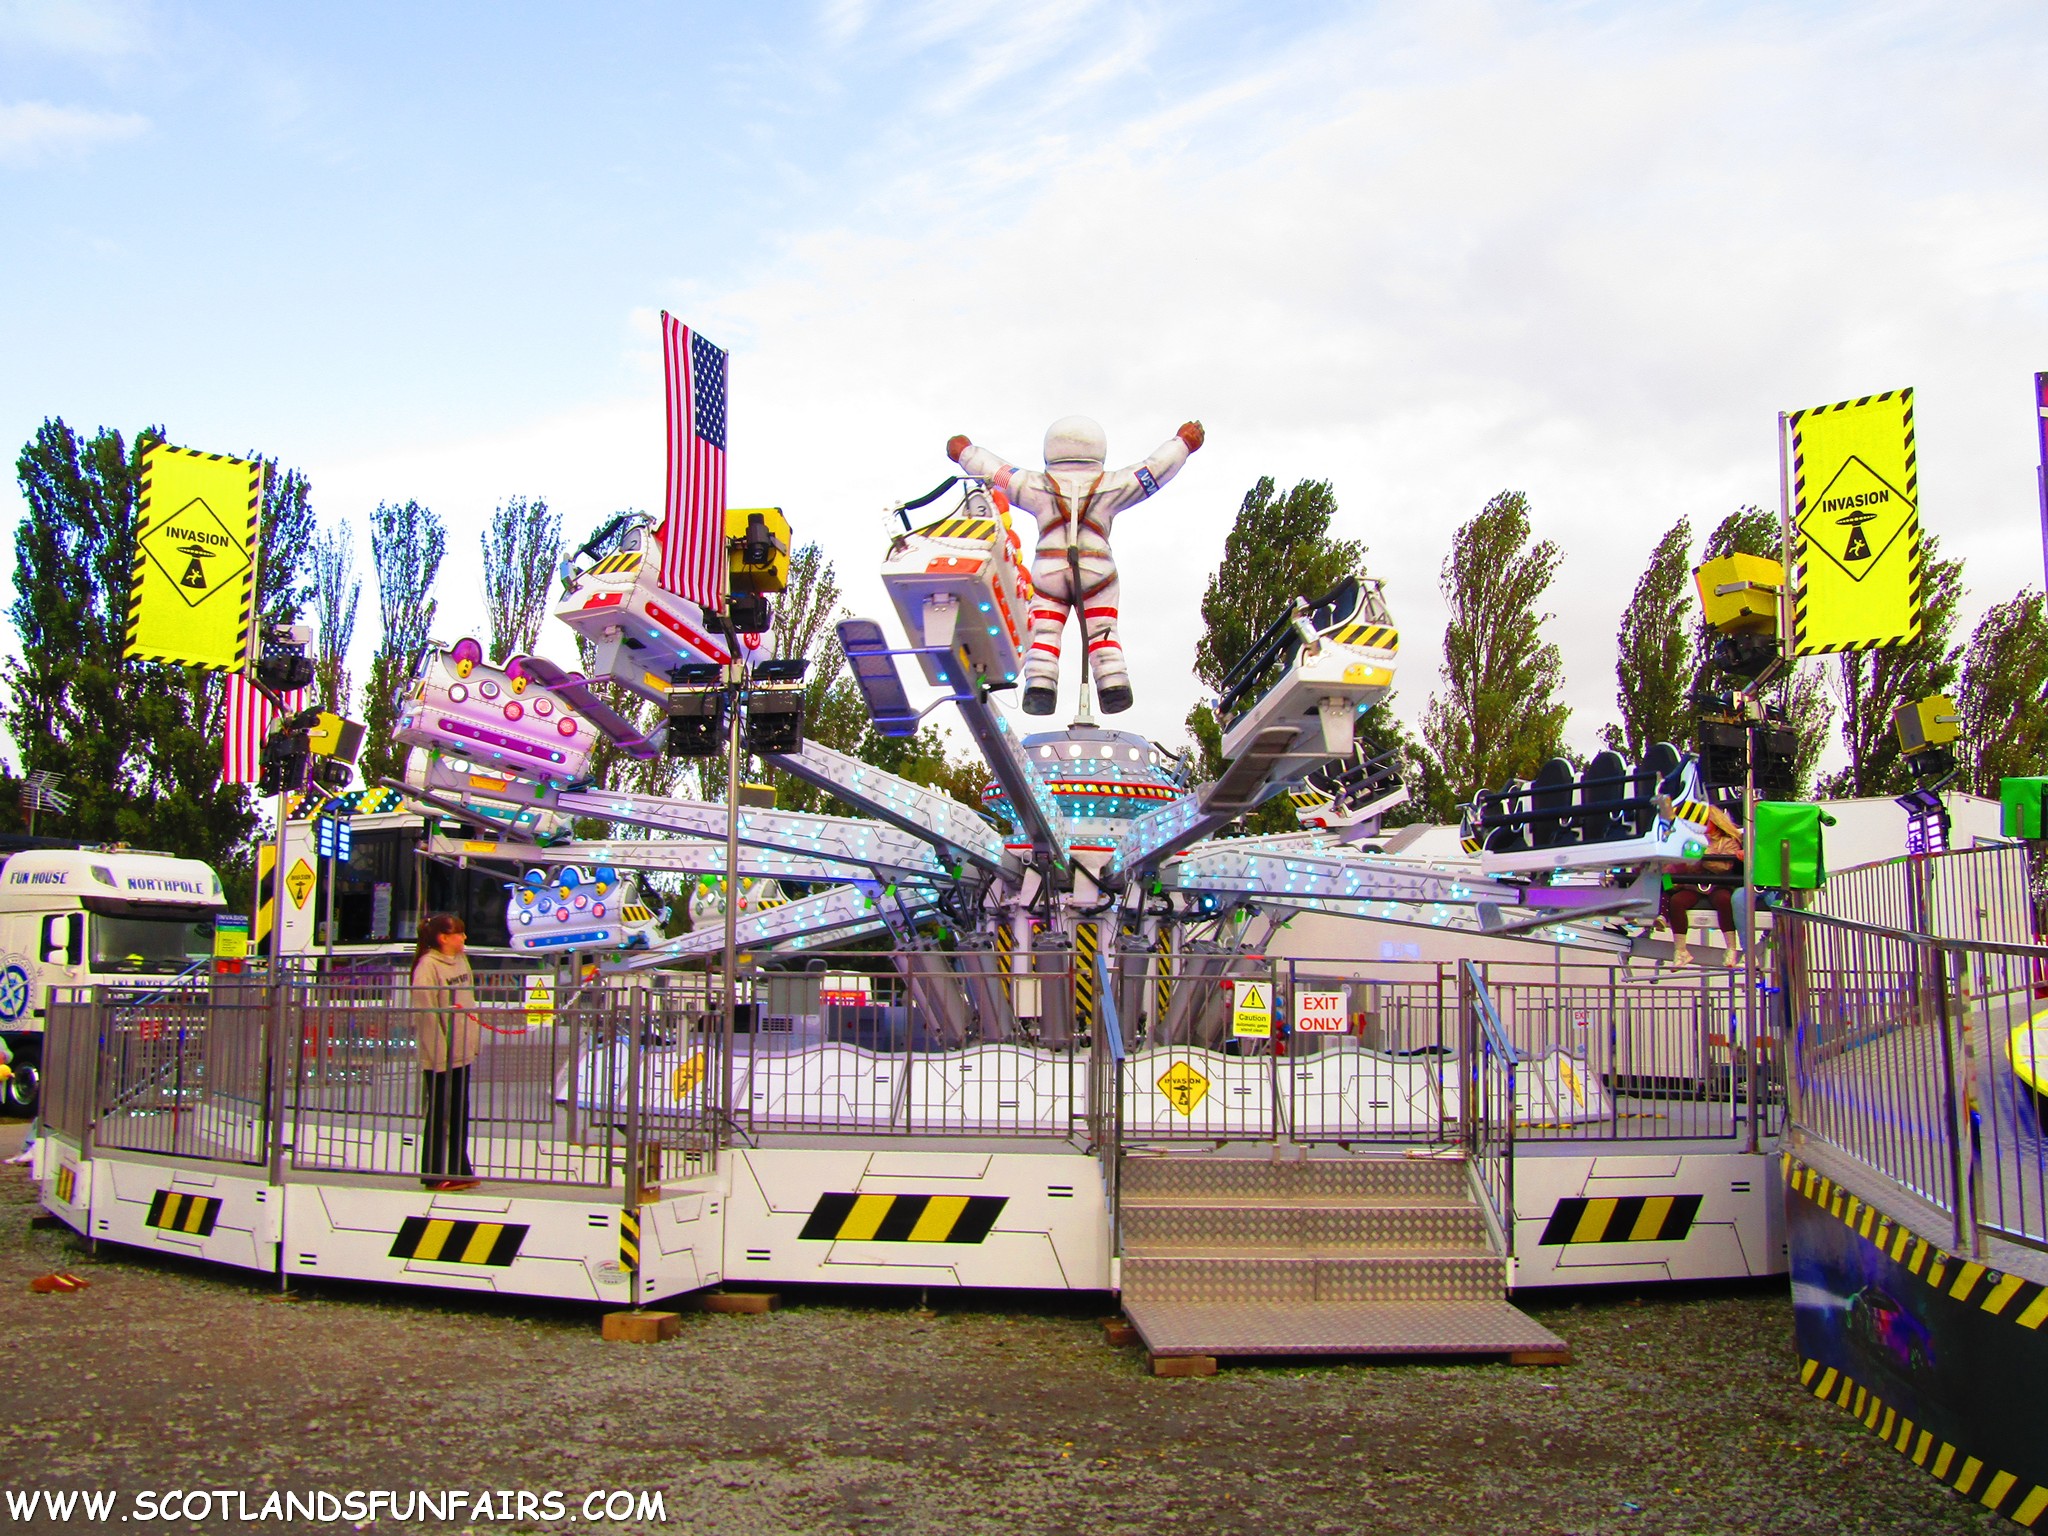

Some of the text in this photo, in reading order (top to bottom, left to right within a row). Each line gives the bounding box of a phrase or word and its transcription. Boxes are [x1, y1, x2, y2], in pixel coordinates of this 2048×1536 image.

[1823, 490, 1889, 512] INVASION
[166, 526, 229, 547] INVASION
[10, 871, 69, 884] FUN HOUSE
[127, 878, 204, 894] NORTHPOLE
[1304, 997, 1339, 1010] EXIT
[1239, 1013, 1266, 1022] Caution
[1300, 1018, 1343, 1031] ONLY
